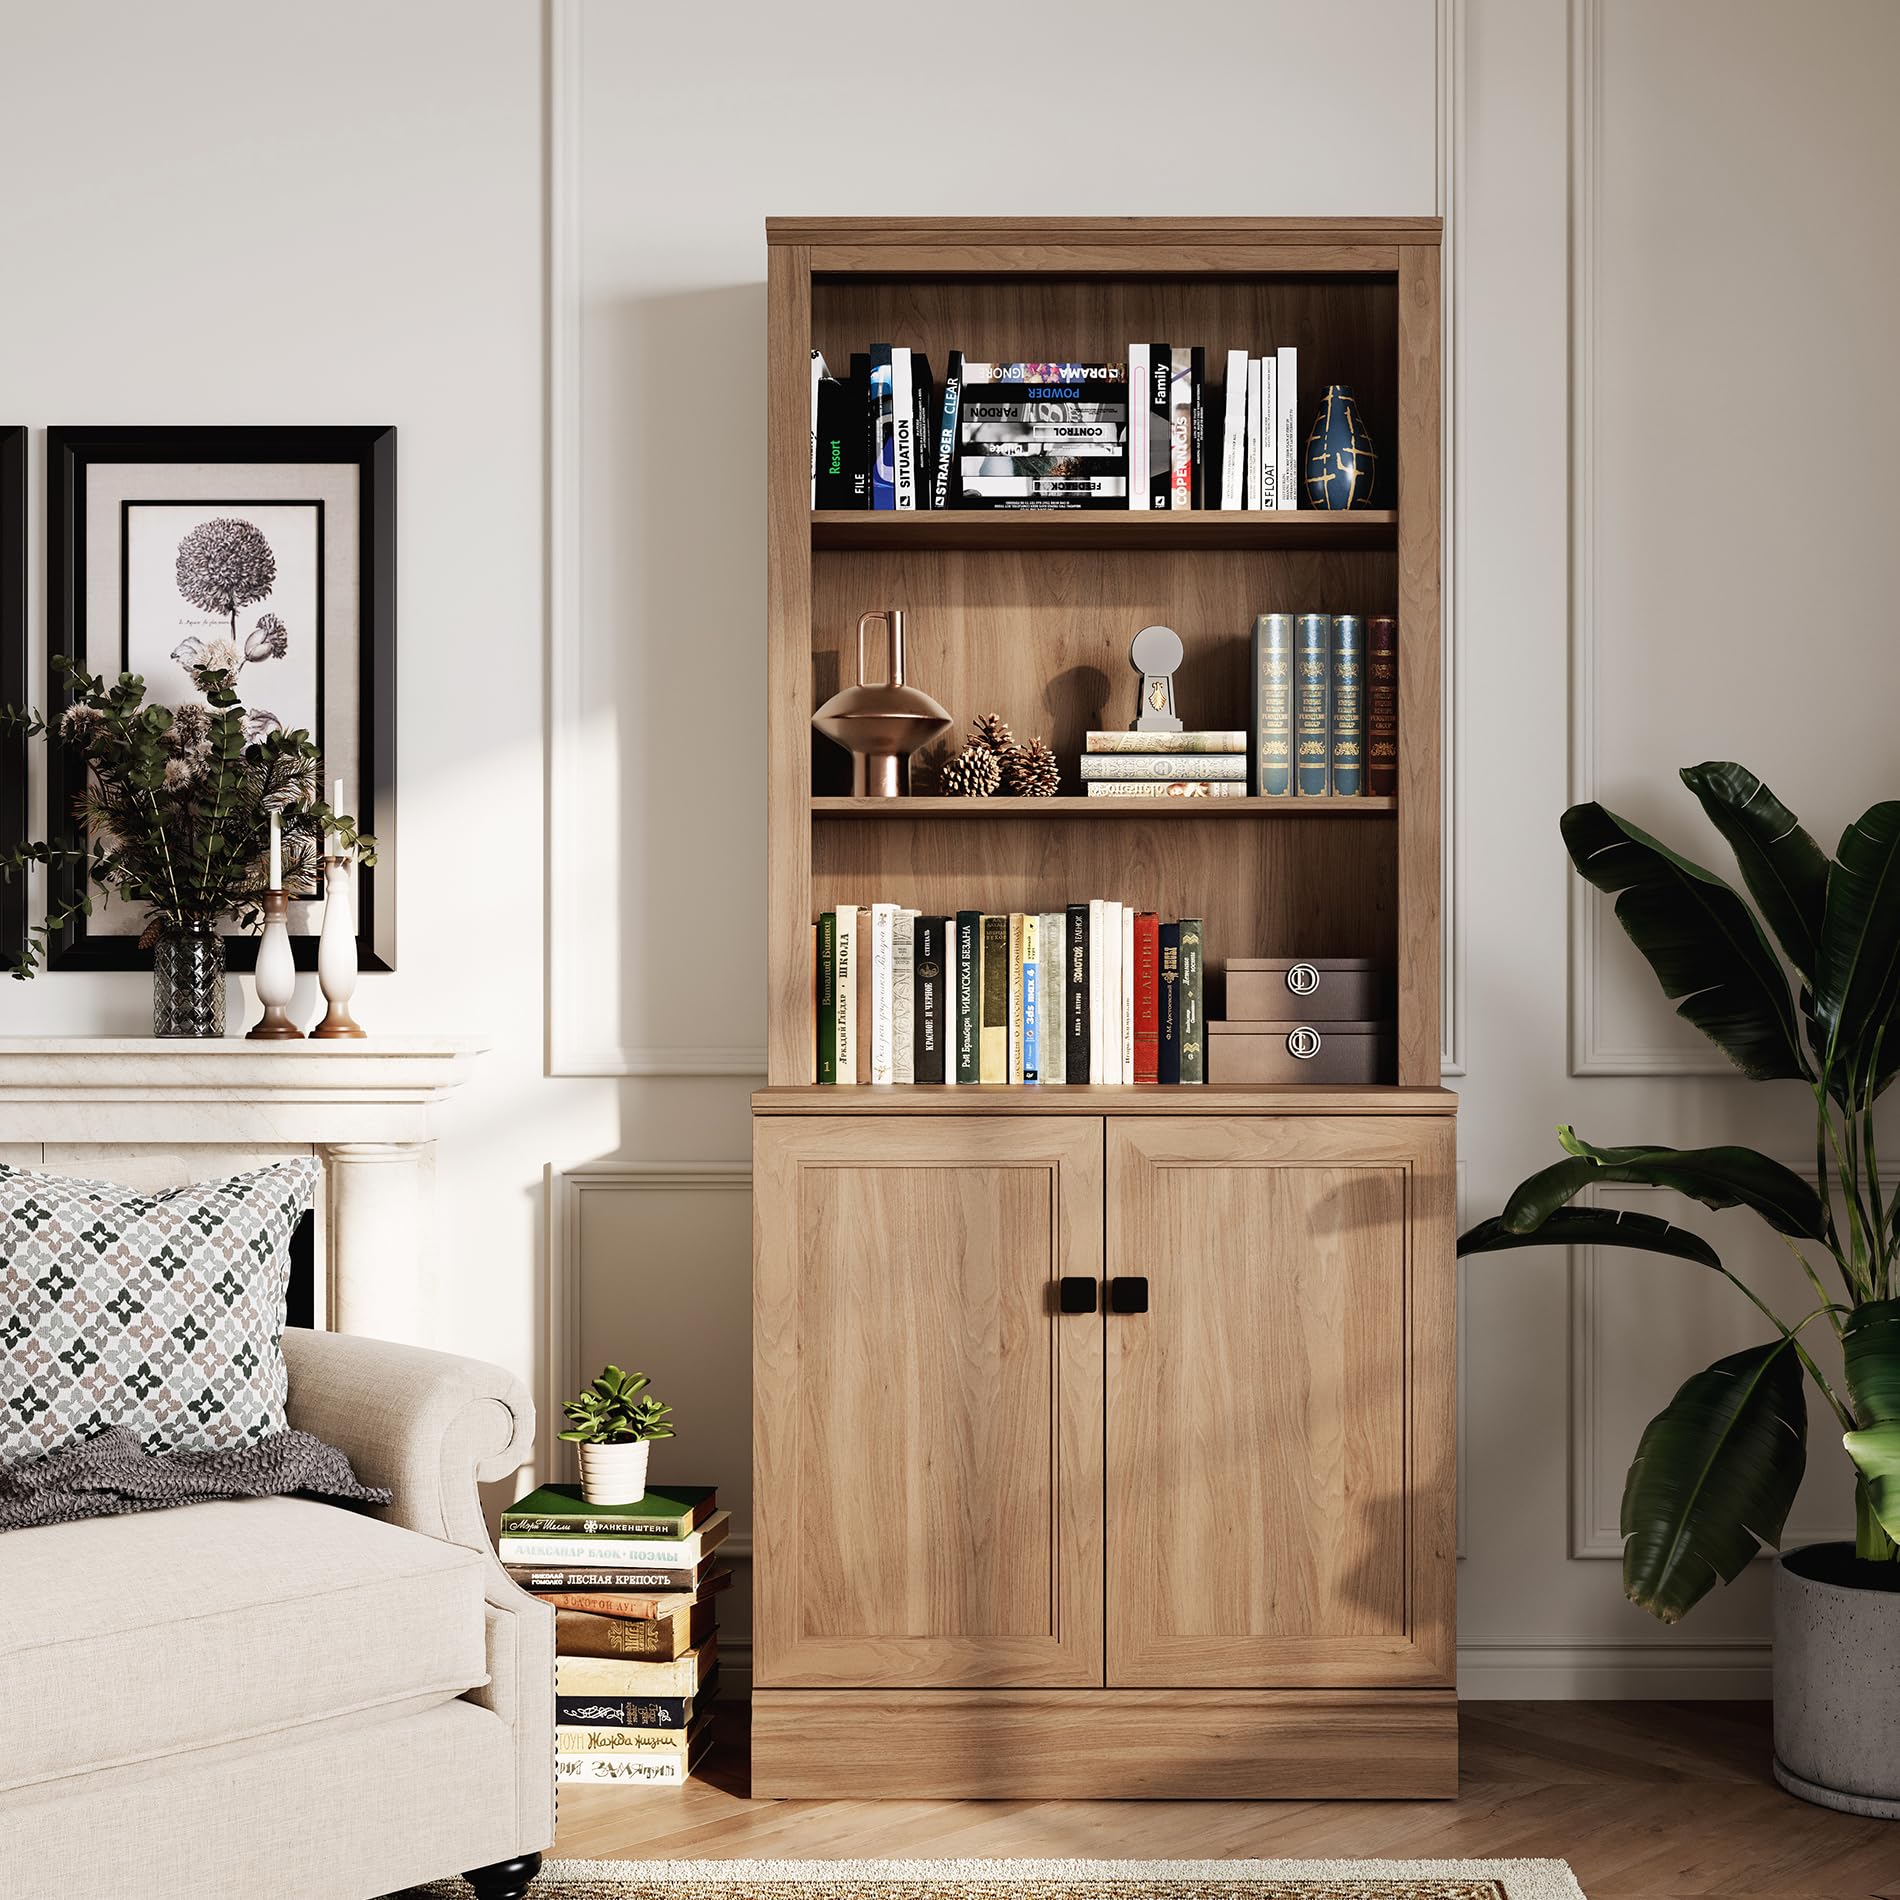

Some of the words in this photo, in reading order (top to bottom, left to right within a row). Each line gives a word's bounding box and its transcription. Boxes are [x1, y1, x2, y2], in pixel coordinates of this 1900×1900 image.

[1060, 367, 1107, 379] DRAMA
[1155, 363, 1169, 405] Family
[944, 377, 959, 414] CLEAR
[1028, 388, 1080, 399] POWDER
[970, 407, 1018, 418] PARDON
[1053, 426, 1103, 437] CONTROL
[829, 440, 841, 474] Resort
[899, 419, 911, 488] SITUATION
[936, 428, 953, 495] STRANGER
[1175, 416, 1188, 506] COPERNICUS
[854, 473, 865, 494] FILE
[1264, 463, 1275, 499] FLOAT
[822, 920, 831, 959] Бианки
[961, 925, 971, 960] БЕЗДНА
[839, 933, 849, 978] ШКОЛА
[1072, 946, 1083, 983] ЗОЛОТОЙ
[823, 960, 831, 1006] Виталий
[1026, 968, 1035, 977] 4
[924, 982, 933, 1011] ЧЕРНОЕ
[1026, 980, 1035, 1002] max
[1026, 1005, 1035, 1025] 3ds
[925, 1019, 934, 1051] КРАСНОЕ
[961, 1053, 971, 1068] Рэй
[509, 1519, 539, 1532] Мэри
[515, 1545, 584, 1557] АЛЕКСАНДР
[588, 1549, 622, 1559] БЛОК
[629, 1551, 679, 1562] ПОЭМЫ
[567, 1574, 612, 1585] ЛЕСНАЯ
[615, 1575, 671, 1585] КРЕПОСТЬ
[616, 1602, 636, 1612] ЛУГ
[587, 1731, 632, 1750] Жажда
[635, 1733, 678, 1750] жизни
